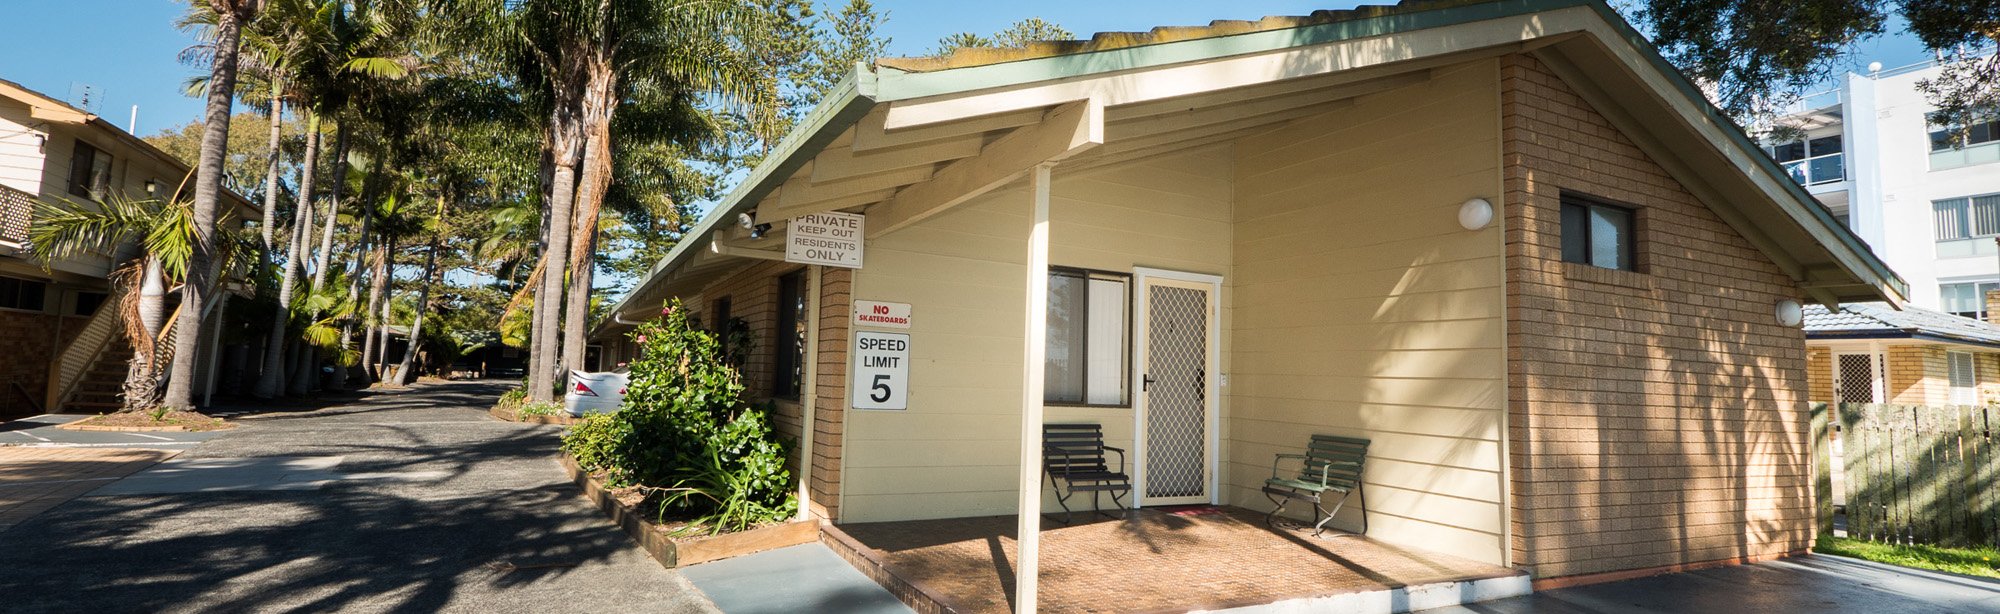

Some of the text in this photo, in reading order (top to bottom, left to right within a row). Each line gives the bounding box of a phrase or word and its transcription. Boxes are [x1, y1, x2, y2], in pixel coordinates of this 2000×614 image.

[796, 214, 857, 229] PRIVATE
[797, 225, 855, 238] KEEP OUT
[795, 237, 856, 251] RESIDENTS
[806, 249, 844, 262] ONLY
[873, 304, 889, 315] NO
[859, 314, 907, 325] SKATEBOARDS
[859, 337, 906, 352] SPEED
[863, 355, 900, 369] LIMIT
[870, 374, 892, 403] 5
